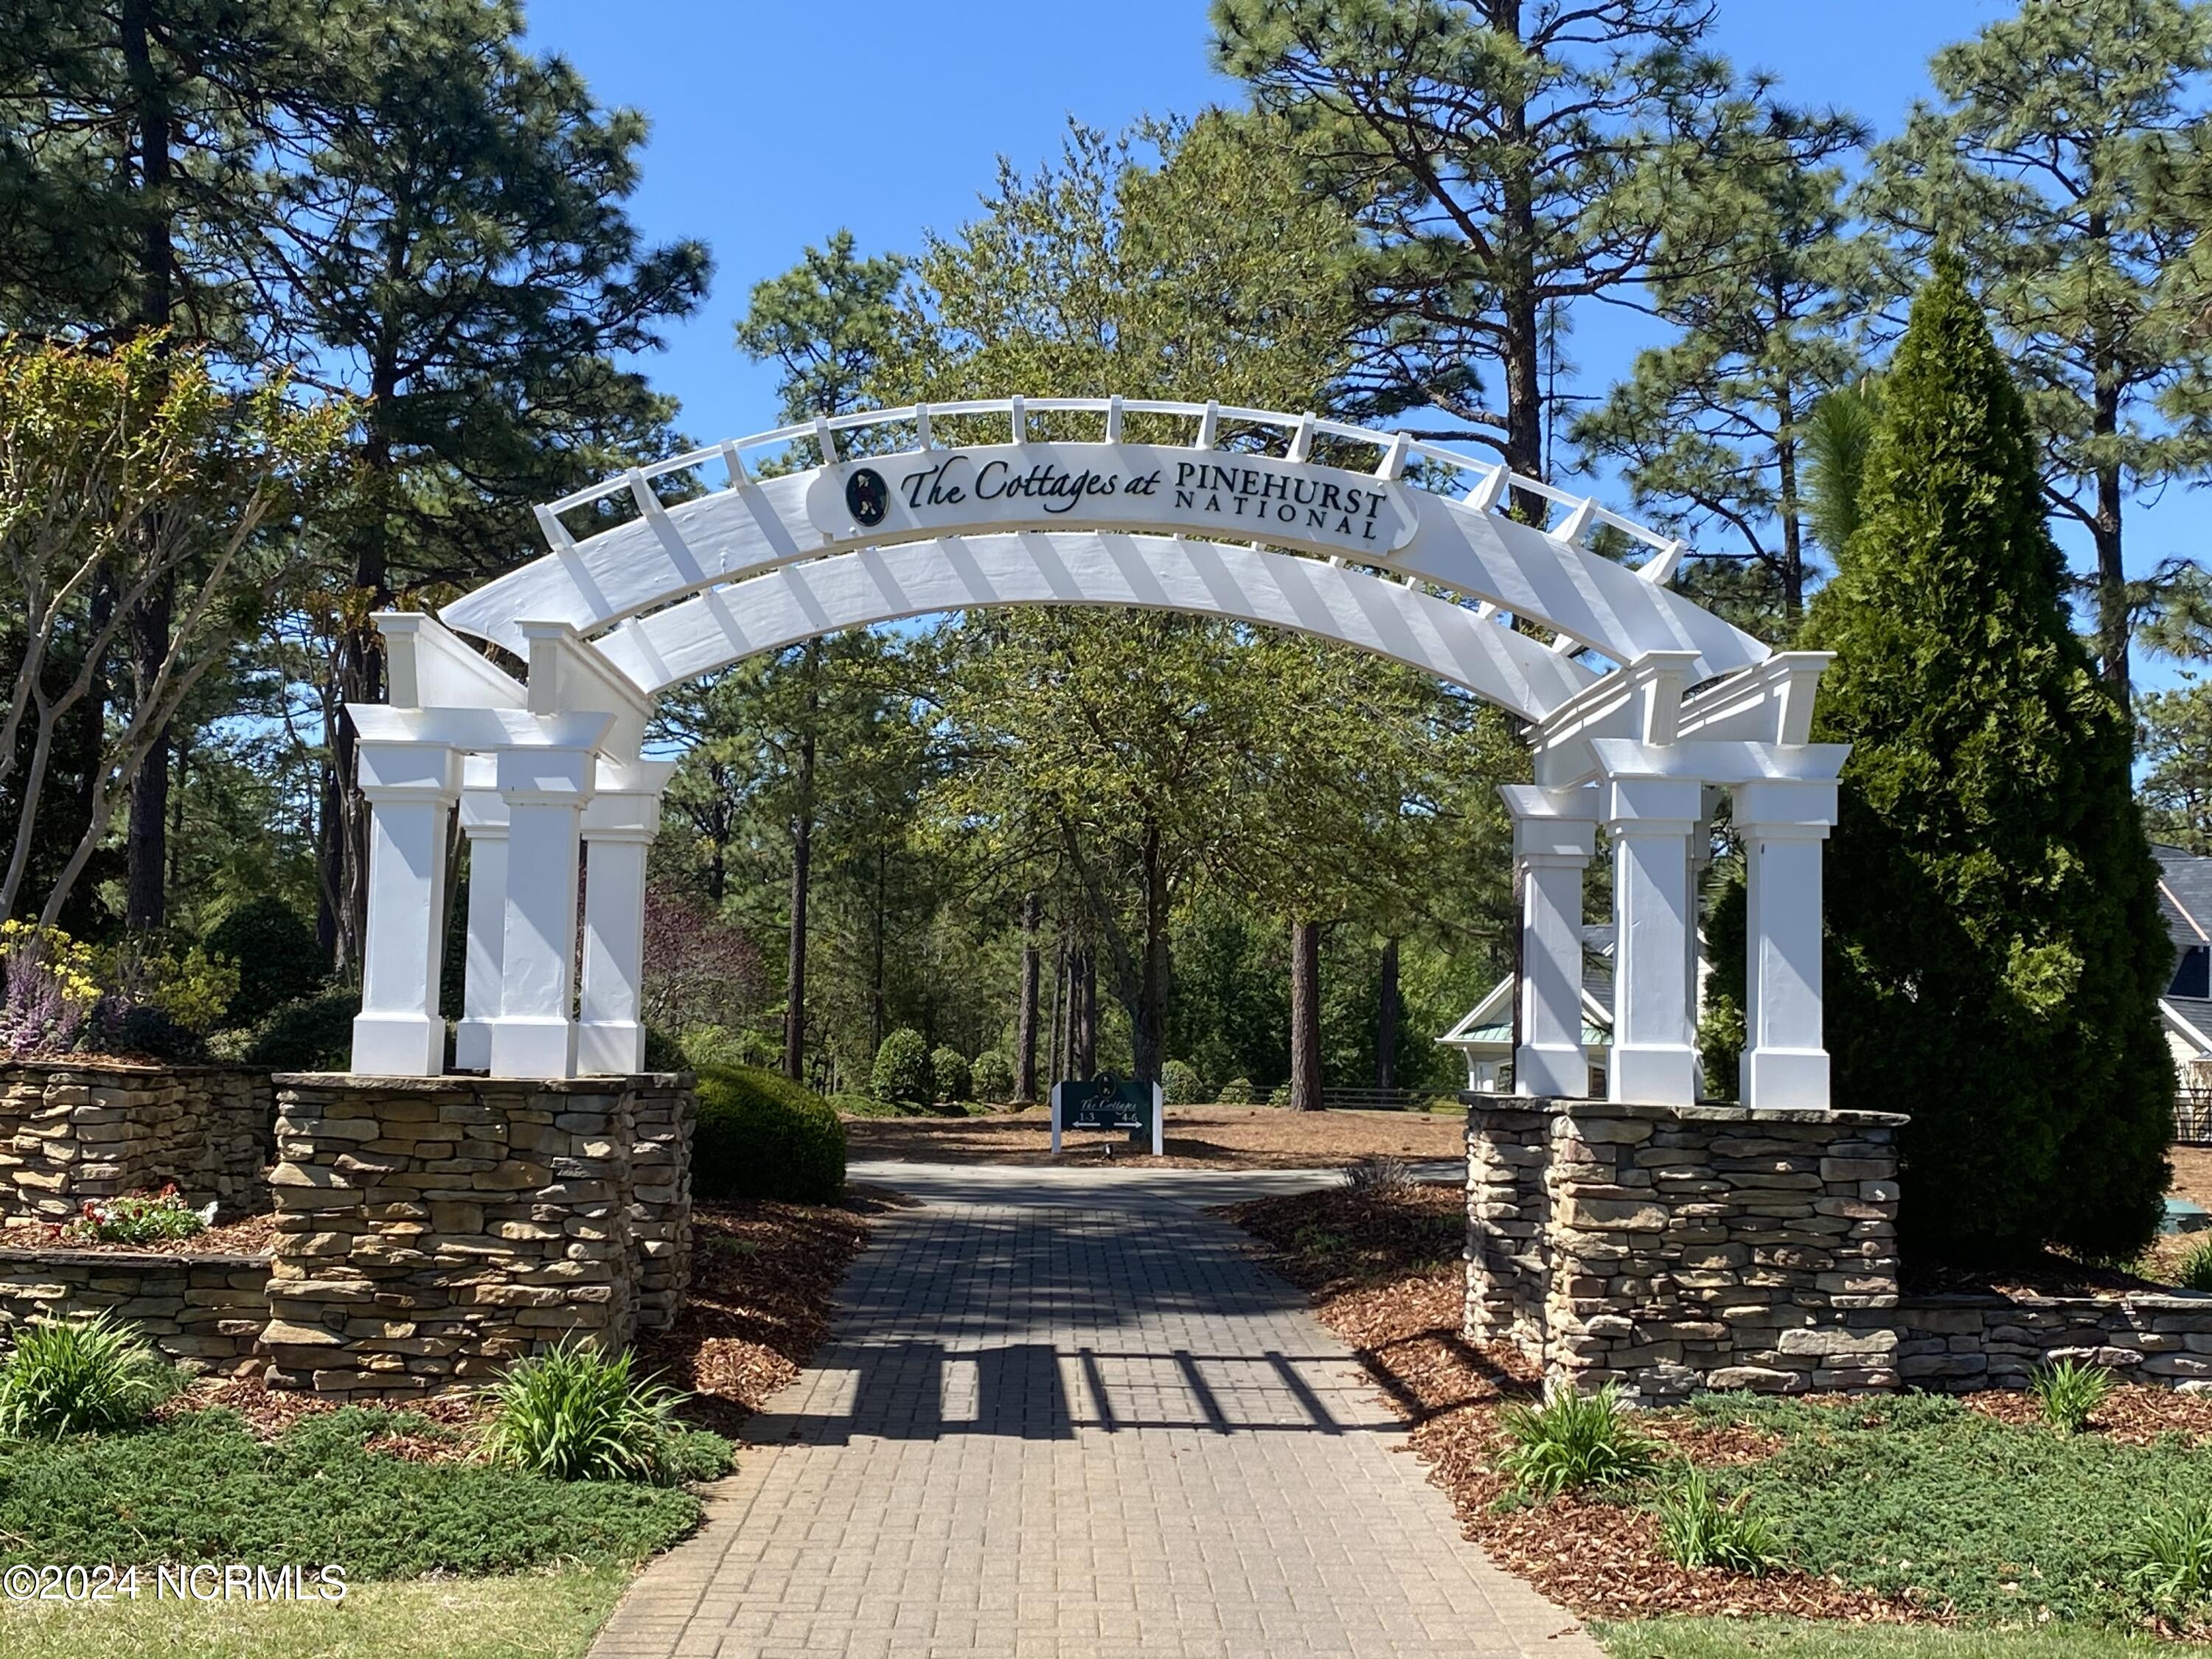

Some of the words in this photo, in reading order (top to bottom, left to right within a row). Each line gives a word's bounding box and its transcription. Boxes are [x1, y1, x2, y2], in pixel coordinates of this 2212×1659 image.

[900, 455, 968, 509] The
[975, 459, 1117, 514] Cottages
[1124, 470, 1161, 496] at
[1175, 462, 1386, 519] PINEHURST
[1175, 490, 1377, 540] NATIONAL
[1080, 1113, 1095, 1121] 1-3
[1121, 1113, 1138, 1121] 4-6
[1081, 1095, 1098, 1110] The
